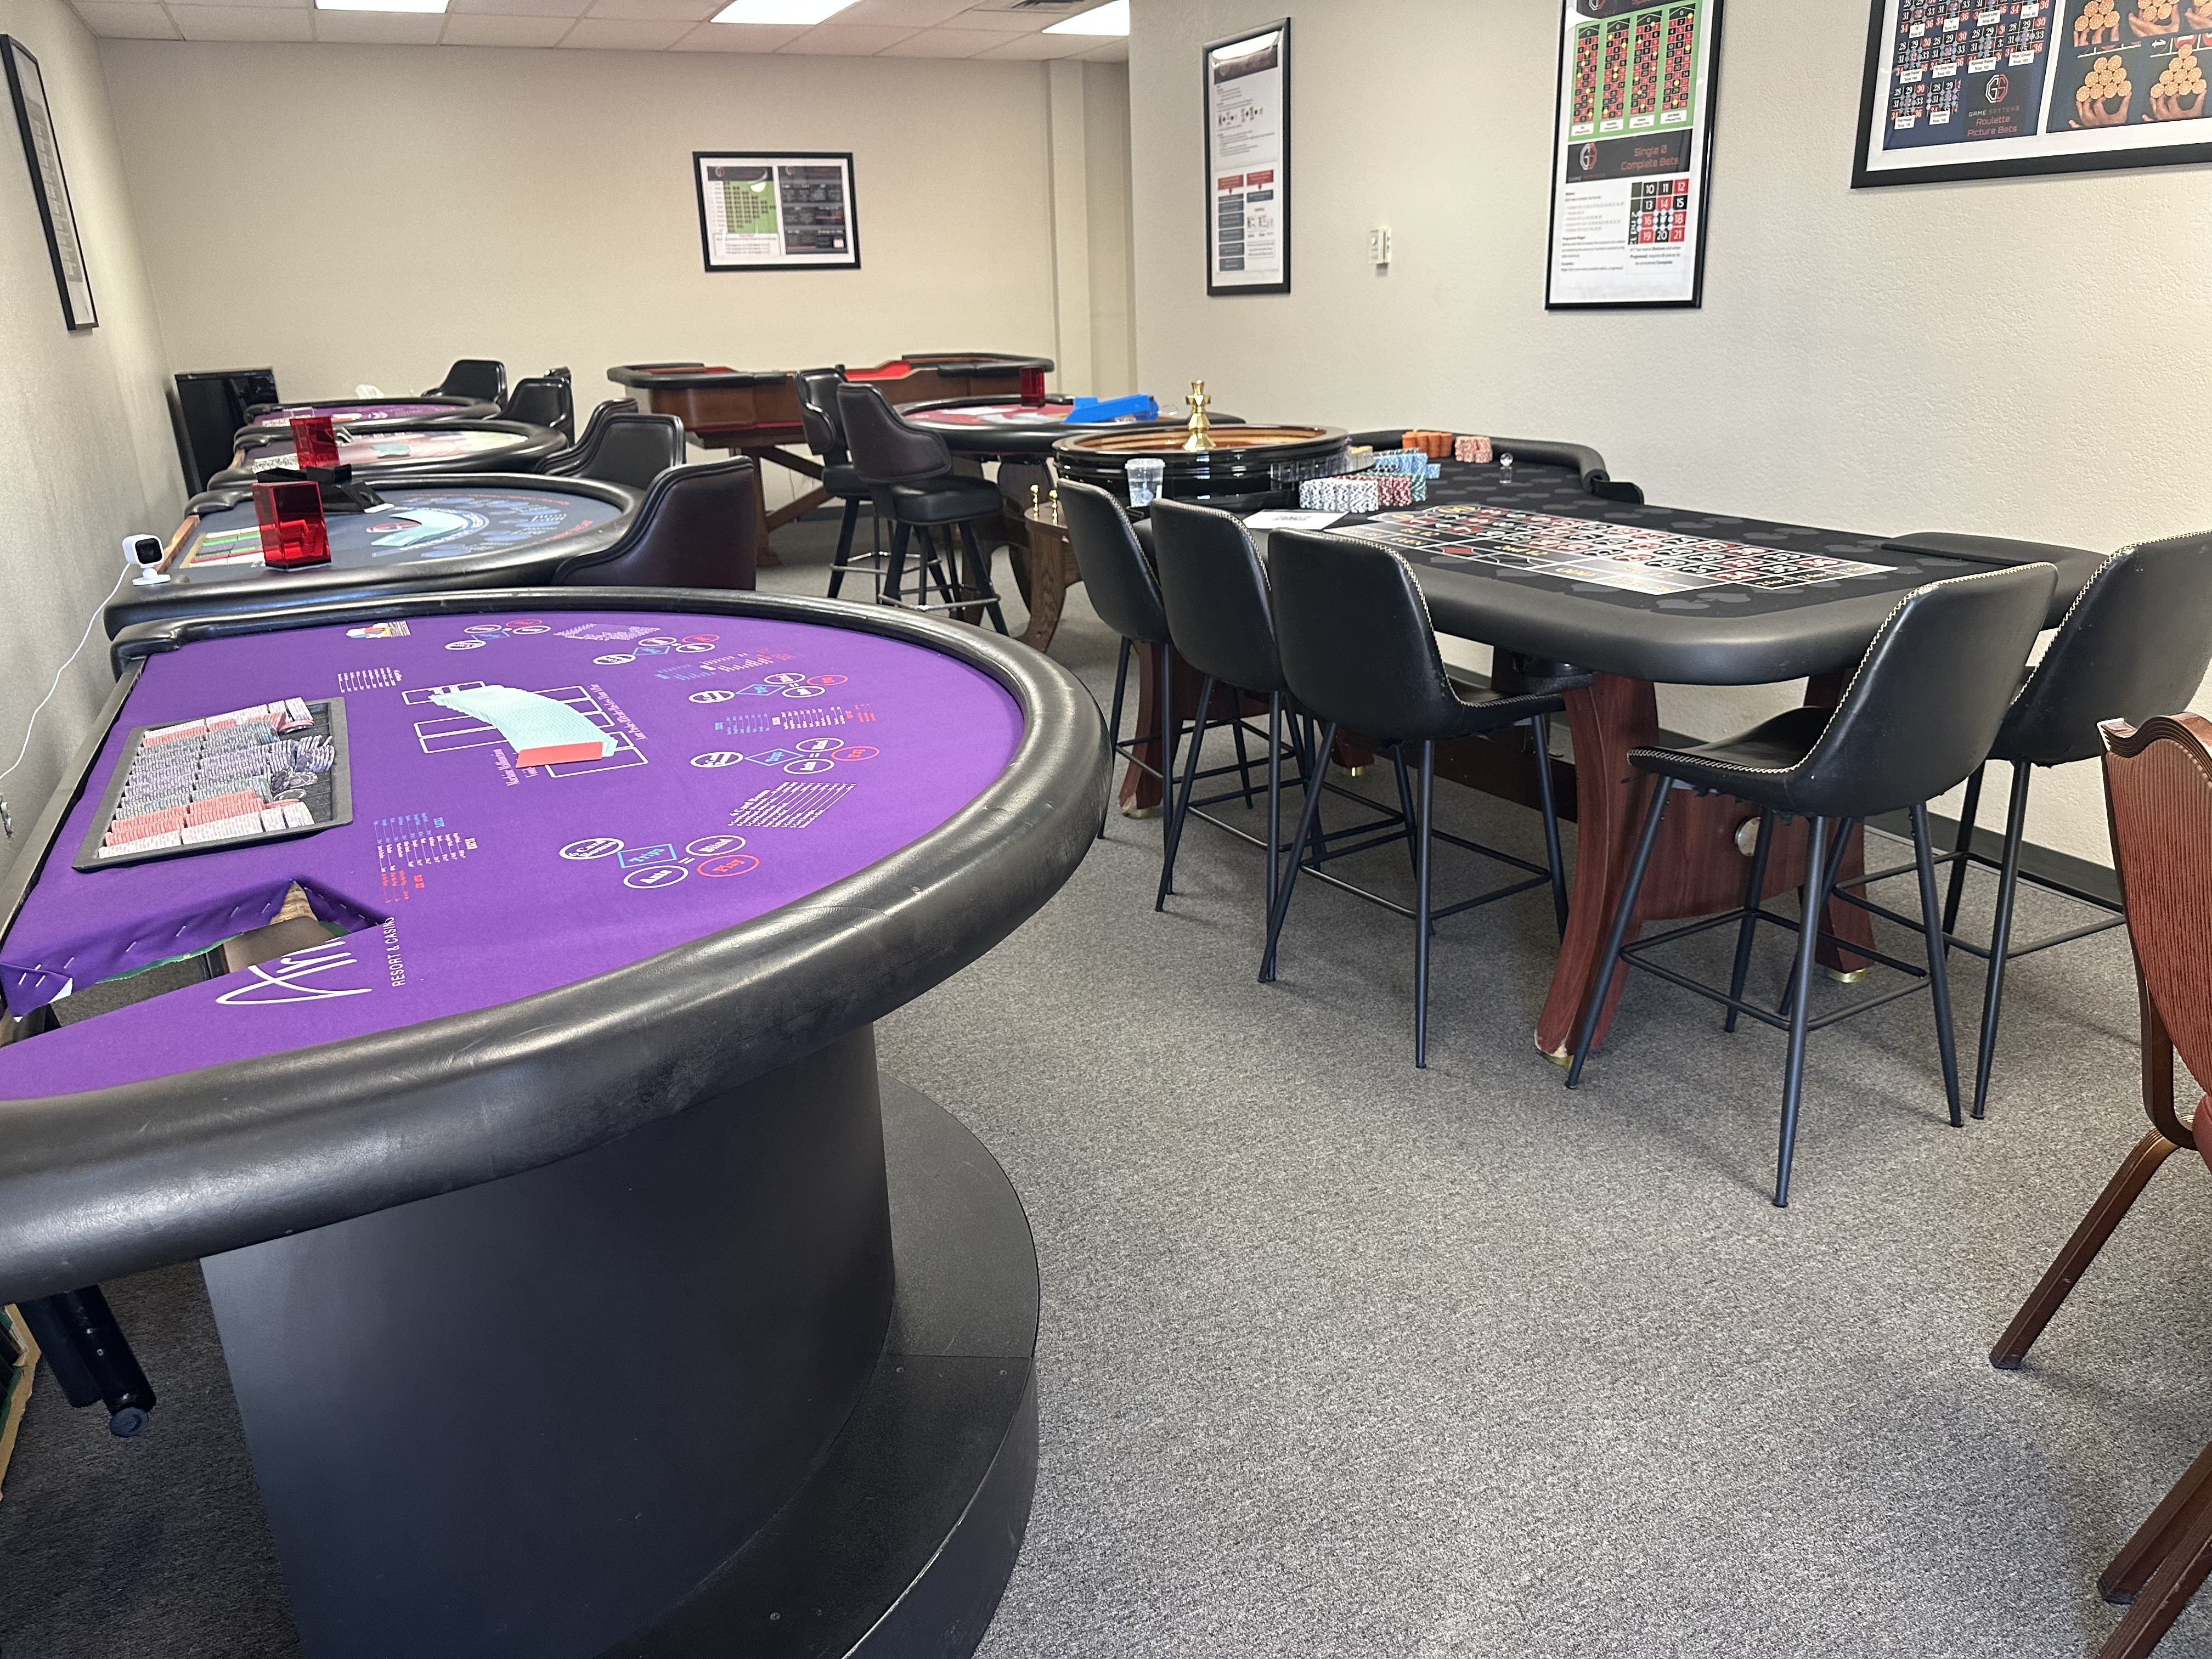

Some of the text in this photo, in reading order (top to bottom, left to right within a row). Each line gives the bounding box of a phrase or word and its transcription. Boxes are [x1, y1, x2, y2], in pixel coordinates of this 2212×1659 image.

[1962, 1, 1970, 9] 33
[2011, 5, 2018, 14] 34
[1903, 12, 1909, 22] 31
[1936, 16, 1943, 25] 34
[1960, 13, 1968, 21] 36
[1926, 19, 1933, 29] 36
[2022, 20, 2031, 29] 29
[2037, 18, 2046, 26] 30
[1900, 24, 1908, 33] 34
[1986, 27, 1994, 36] 29
[2008, 23, 2017, 31] 28
[1959, 32, 1967, 41] 30
[1972, 29, 1980, 38] 28
[2035, 31, 2044, 39] 33
[1923, 38, 1931, 47] 30
[1933, 37, 1940, 46] 28
[1946, 34, 1954, 43] 29
[2007, 36, 2014, 44] 31
[1899, 42, 1906, 50] 28
[1911, 40, 1918, 48] 29
[1971, 43, 1977, 51] 31
[2034, 43, 2042, 52] 36
[1932, 49, 1938, 58] 31
[1957, 45, 1965, 54] 33
[1898, 55, 1904, 63] 31
[1922, 50, 1929, 59] 33
[1956, 58, 1964, 66] 36
[1894, 88, 1901, 96] 28
[1917, 84, 1925, 93] 30
[1933, 83, 1940, 92] 28
[1932, 94, 1938, 103] 31
[1893, 100, 1899, 108] 31
[1915, 109, 1922, 118] 36
[1976, 116, 2010, 126] Roulette
[1967, 125, 2017, 137] Picture Bets
[1634, 146, 1659, 157] Single
[1621, 157, 1679, 170] Complete Bets
[1646, 184, 1655, 194] 10
[1662, 183, 1669, 193] 11
[1678, 182, 1685, 192] 12
[1646, 200, 1653, 210] 13
[1661, 199, 1668, 208] 14
[1677, 198, 1684, 207] 15
[1644, 216, 1652, 225] 16
[1675, 214, 1684, 224] 18
[1643, 231, 1651, 241] 19
[1657, 230, 1667, 240] 20
[1674, 230, 1682, 239] 21
[1663, 537, 1700, 545] 24
[1688, 553, 1726, 561] 29
[1798, 558, 1838, 567] 36
[1682, 565, 1721, 574] 31
[1759, 565, 1798, 573] 35
[1716, 571, 1758, 580] 34
[578, 839, 606, 854] Card
[580, 841, 617, 857] Bonus
[698, 838, 734, 854] Blind
[628, 848, 665, 864] Trips
[712, 858, 746, 873] Play
[639, 869, 673, 884] Ante
[383, 917, 398, 944] CASINO
[387, 953, 406, 987] RESORT
